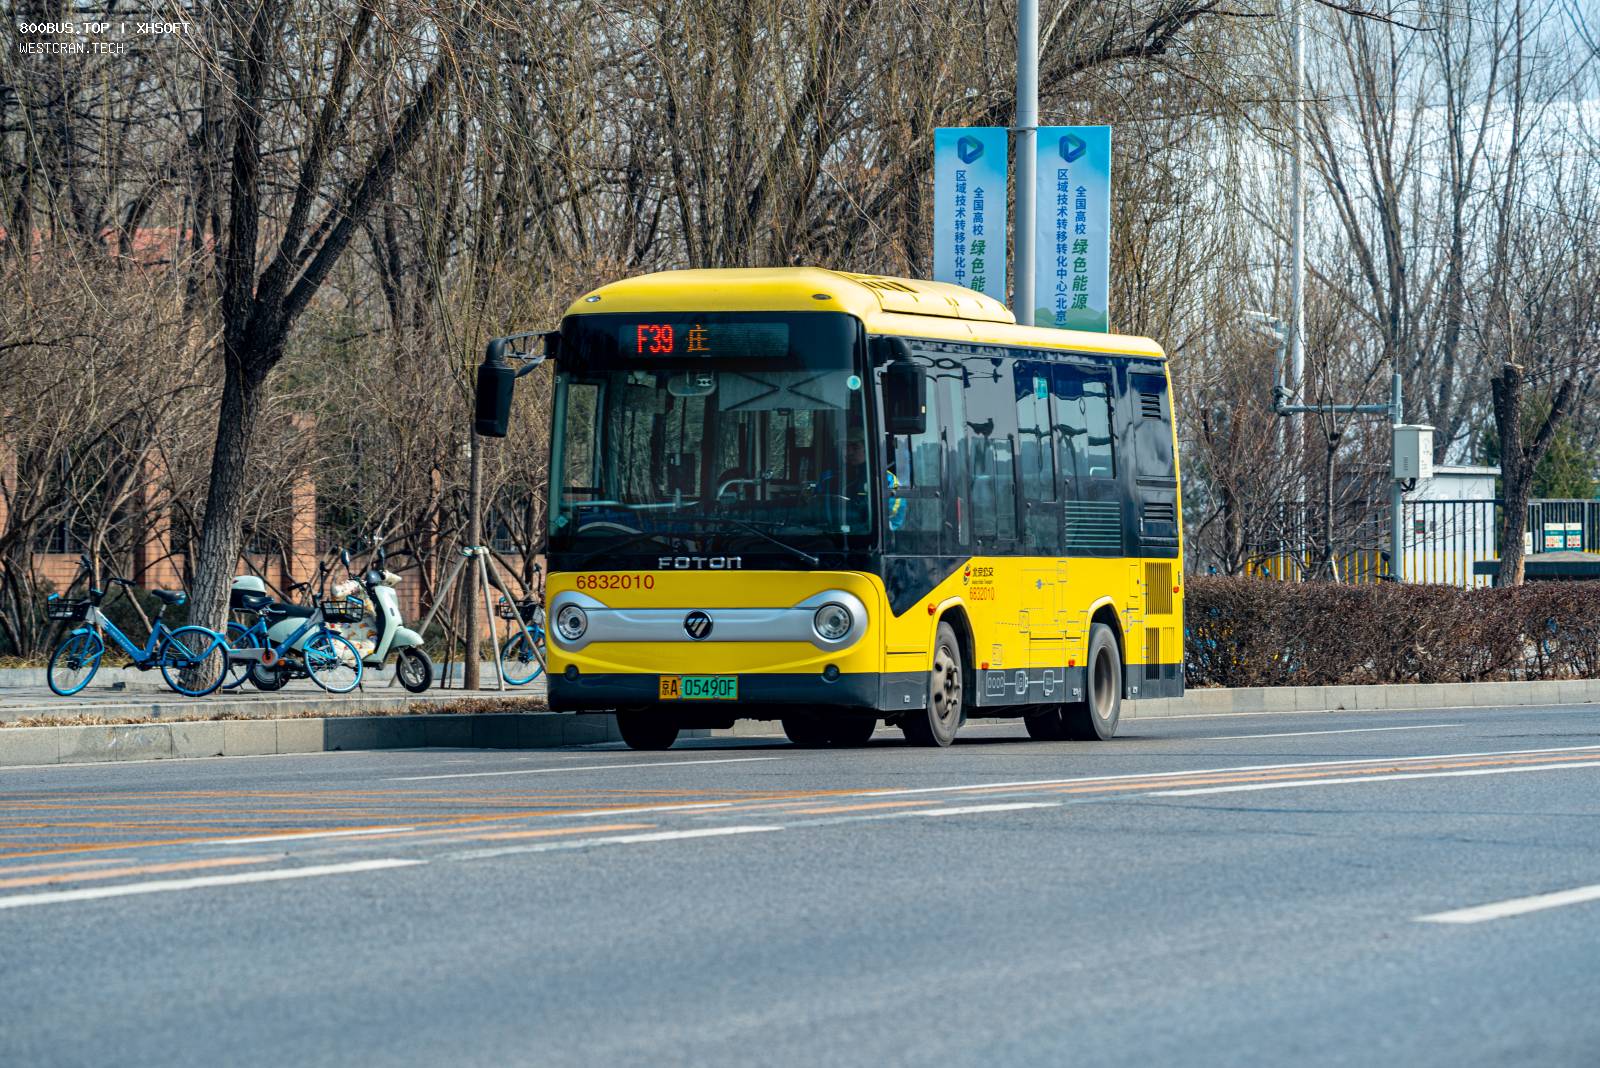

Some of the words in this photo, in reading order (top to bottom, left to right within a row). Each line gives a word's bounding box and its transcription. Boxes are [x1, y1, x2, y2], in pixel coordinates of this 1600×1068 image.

[637, 324, 673, 353] F39
[686, 324, 711, 352] 庄
[658, 556, 742, 569] FOTON
[575, 574, 655, 590] 6832010
[970, 587, 994, 600] 6832010
